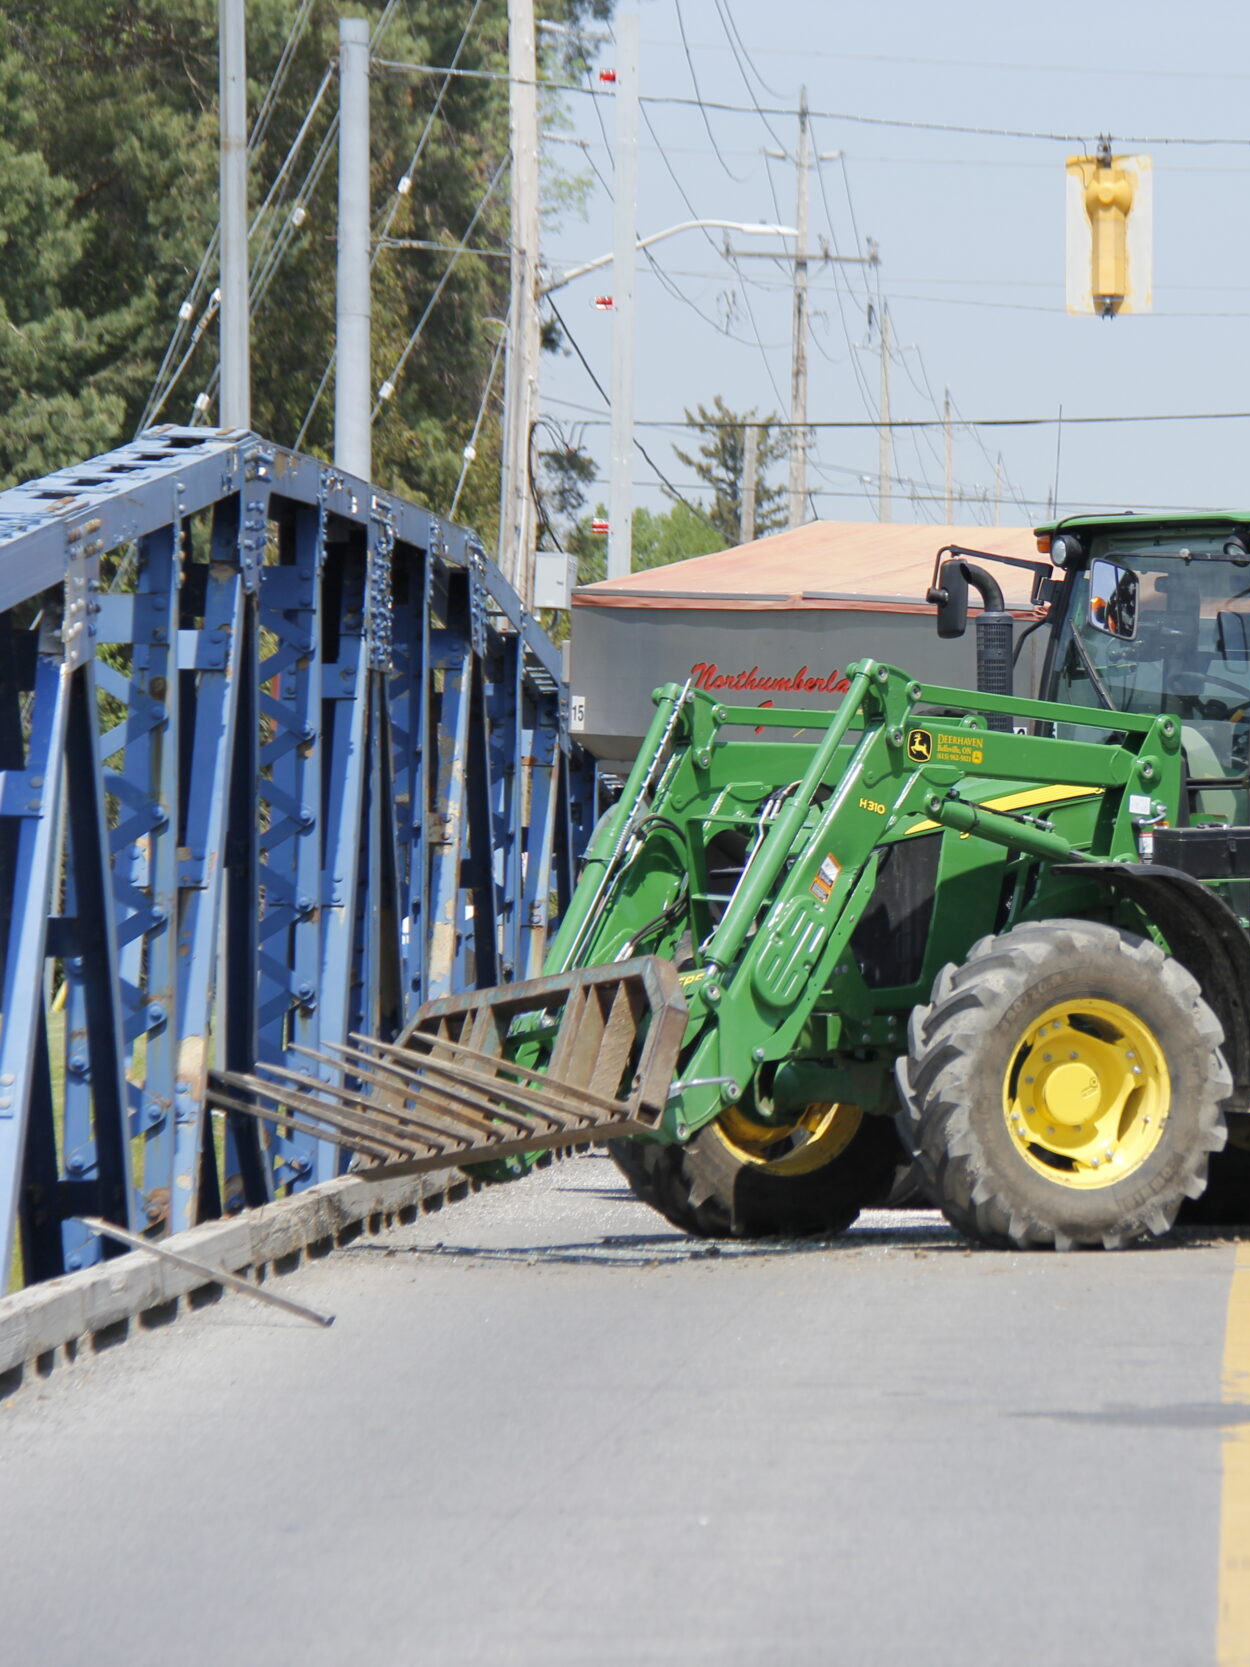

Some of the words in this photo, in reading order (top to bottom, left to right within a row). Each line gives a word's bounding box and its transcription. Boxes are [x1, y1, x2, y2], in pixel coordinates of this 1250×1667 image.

[572, 704, 584, 722] 15
[937, 734, 983, 748] DEERHAVEN
[859, 797, 886, 815] H310
